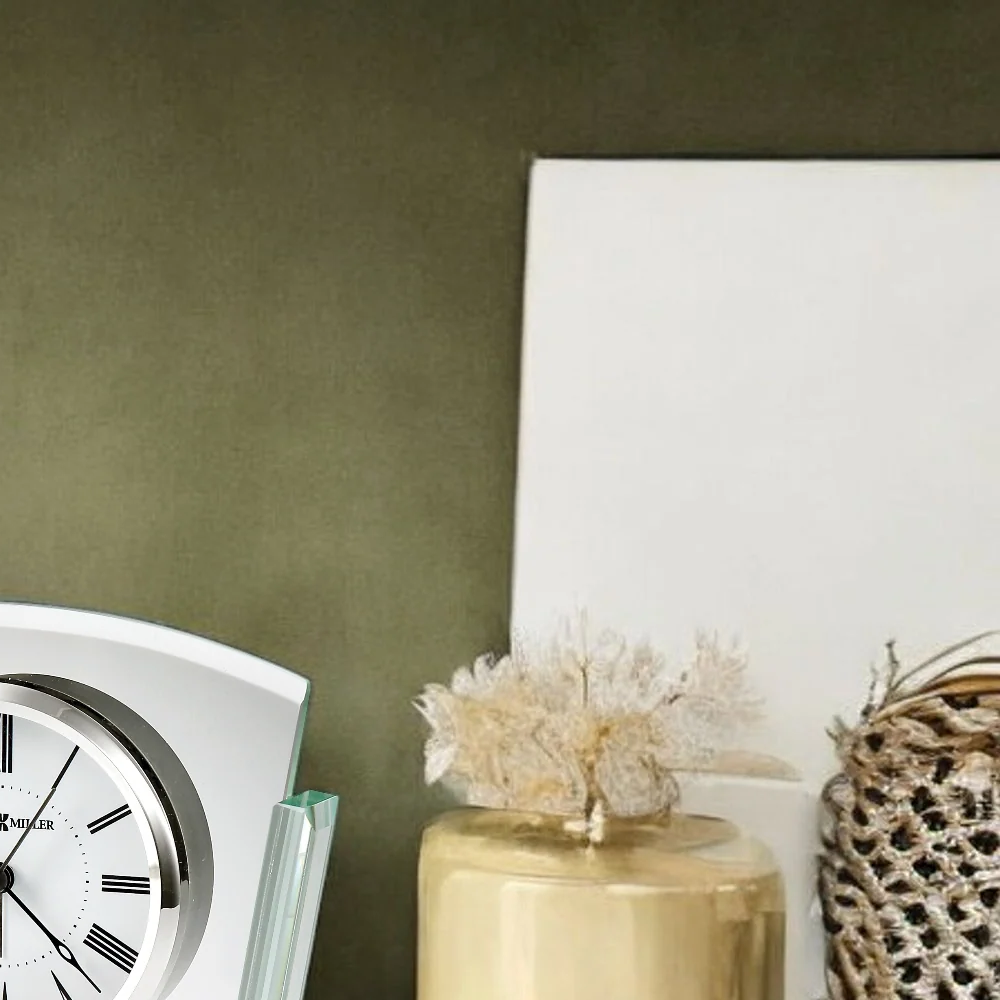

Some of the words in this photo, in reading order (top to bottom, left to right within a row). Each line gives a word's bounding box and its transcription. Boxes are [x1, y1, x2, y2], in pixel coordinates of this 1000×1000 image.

[86, 803, 132, 835] II
[101, 874, 150, 895] III
[82, 922, 140, 974] IIII
